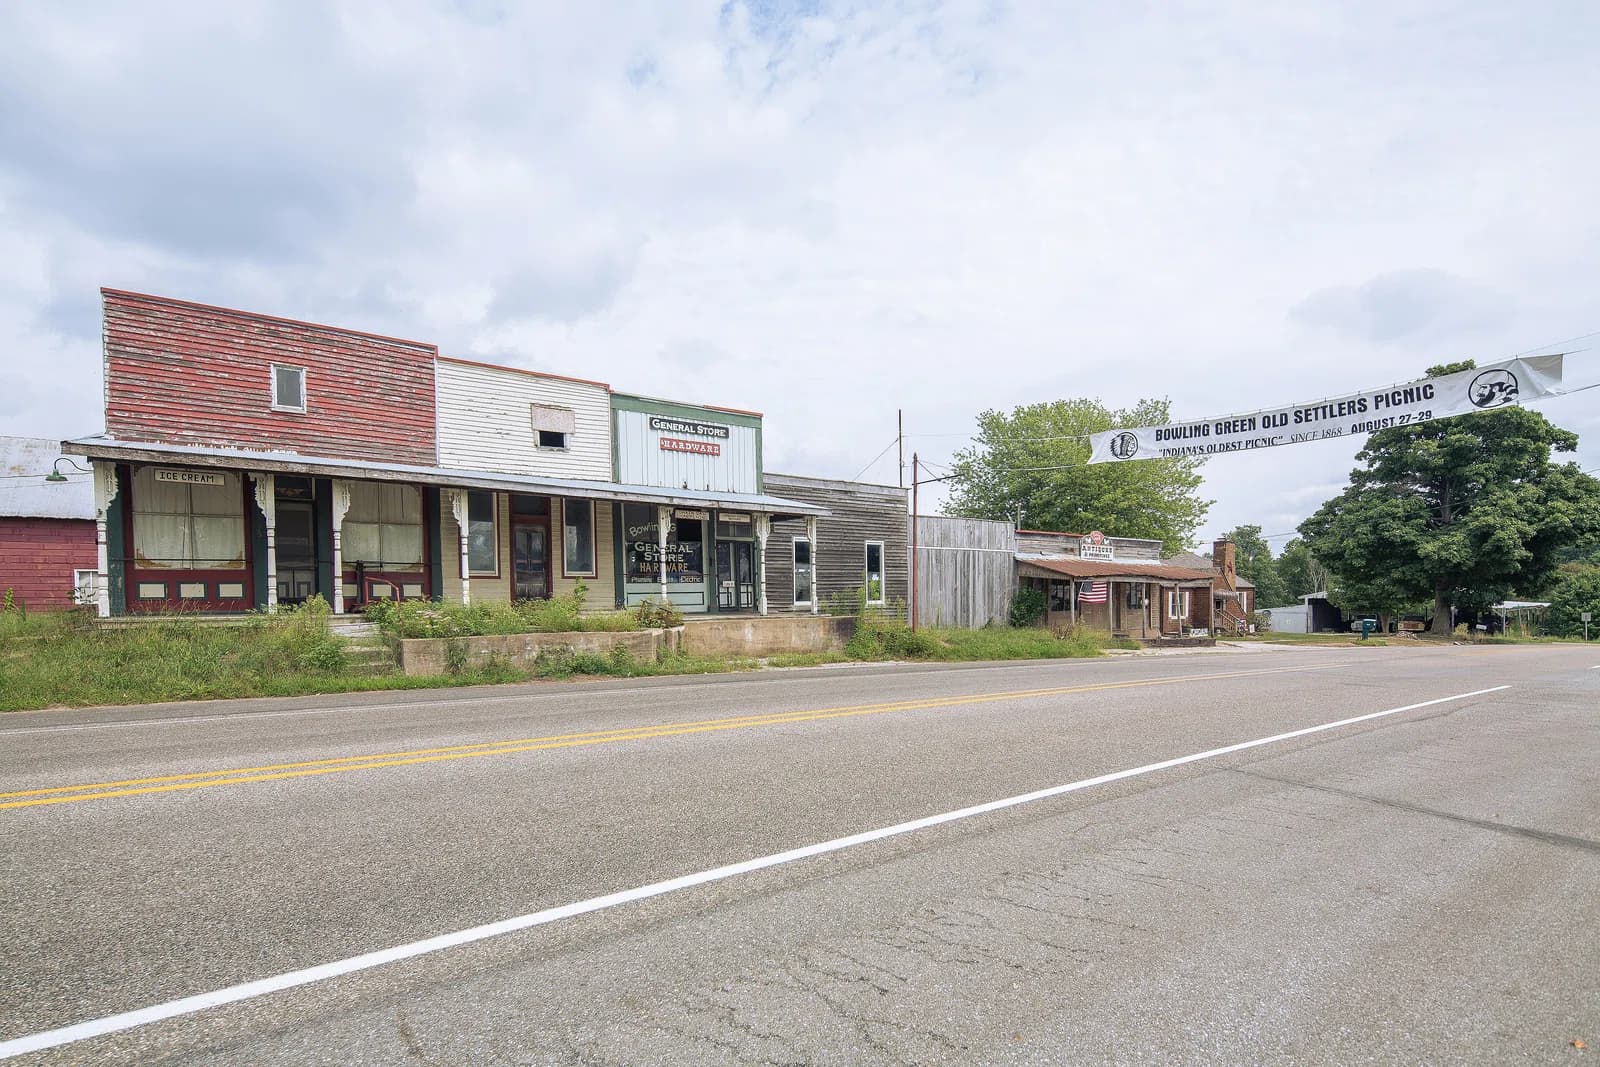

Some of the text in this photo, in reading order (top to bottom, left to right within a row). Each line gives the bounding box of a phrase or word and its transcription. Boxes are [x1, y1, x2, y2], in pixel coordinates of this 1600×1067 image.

[1155, 383, 1435, 441] BOWLING GREEN OLD SETTLERS PICNIC
[652, 419, 727, 437] GENERAL STORE
[1158, 410, 1433, 457] "INDIANA'S OLDEST PICNIC" SINCE 1868 AUGUST 27-29
[664, 440, 720, 453] HARDWARE
[160, 471, 215, 483] ICE CREAM
[640, 562, 689, 573] HARWARE
